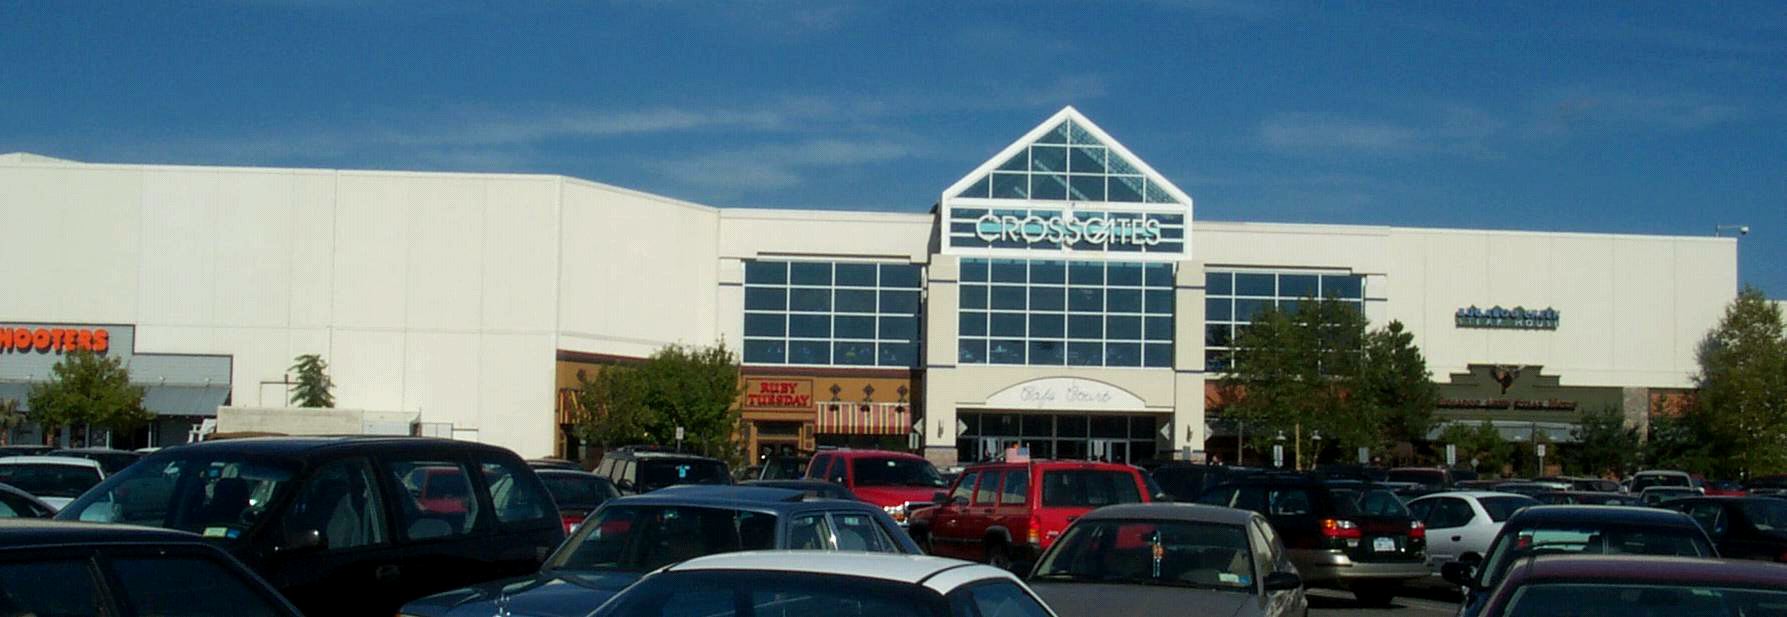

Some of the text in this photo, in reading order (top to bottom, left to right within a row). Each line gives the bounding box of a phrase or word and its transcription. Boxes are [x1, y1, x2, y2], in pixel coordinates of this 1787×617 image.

[975, 214, 1162, 246] CROSSGATES
[0, 327, 109, 354] HOOTERS
[760, 382, 798, 394] RUBY
[748, 394, 810, 406] TUESDAY
